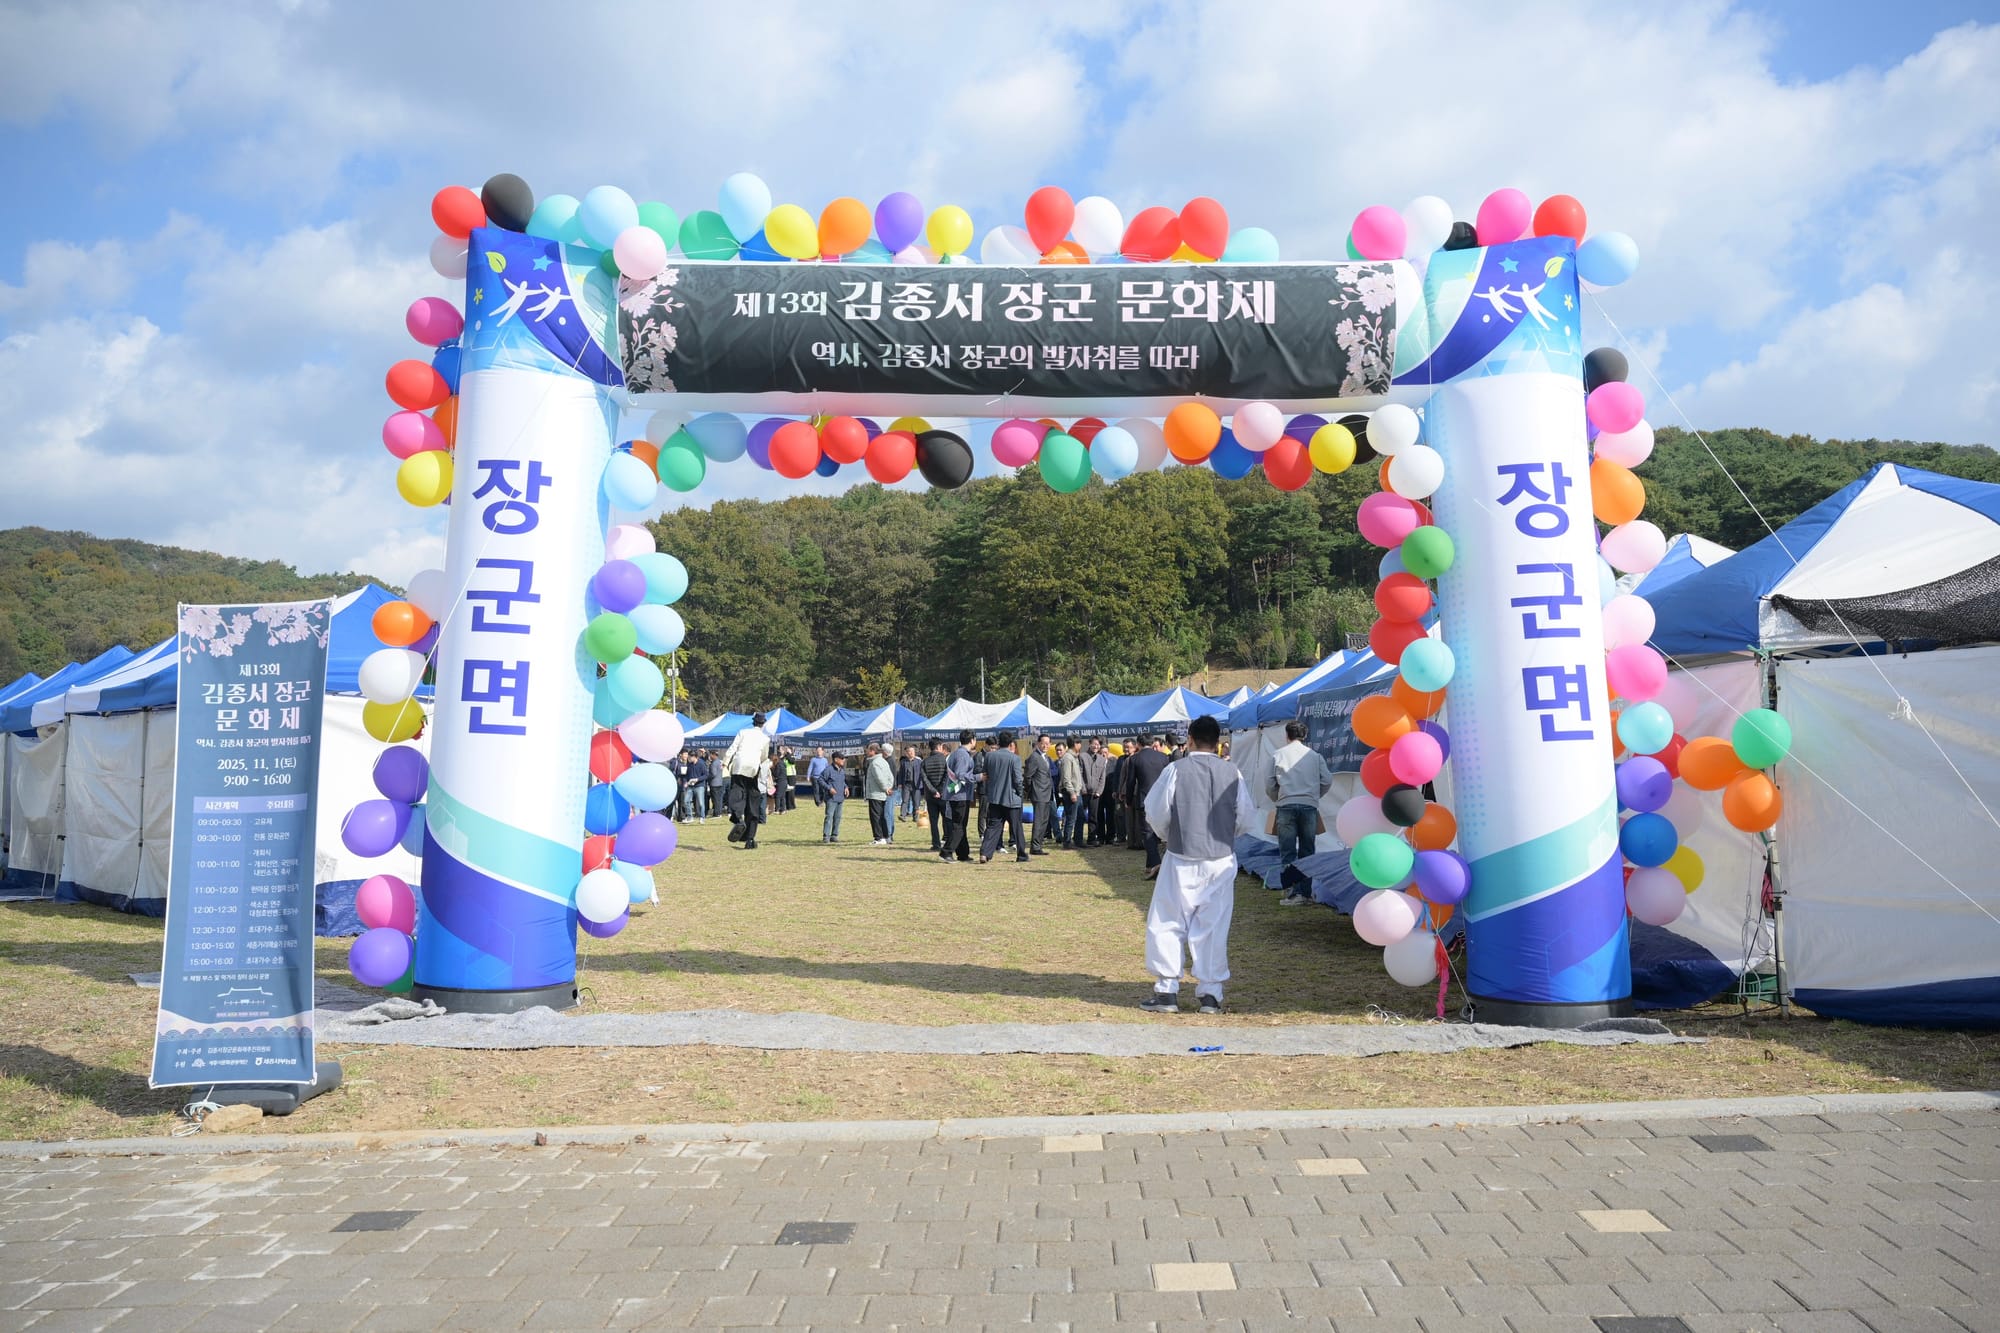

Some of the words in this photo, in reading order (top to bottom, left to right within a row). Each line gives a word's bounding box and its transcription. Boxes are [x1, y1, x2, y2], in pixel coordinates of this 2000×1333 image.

[732, 291, 828, 317] 제13회
[837, 281, 983, 321] 김종서
[999, 282, 1096, 322] 장군
[1117, 280, 1275, 324] 문화제
[811, 341, 868, 369] 역사,
[878, 343, 951, 369] 김종서
[959, 344, 1033, 369] 장군의
[1042, 345, 1141, 370] 발자취를
[1150, 345, 1199, 370] 따라
[461, 459, 552, 735] 장군면
[1497, 462, 1594, 741] 장군면
[239, 663, 280, 677] 제13회
[201, 682, 267, 704] 김종서
[274, 680, 311, 703] 장군
[220, 738, 243, 747] 김종서
[246, 738, 269, 747] 장군의
[217, 759, 248, 770] 2025.
[254, 759, 269, 770] 11.
[274, 757, 297, 769] 1(토)
[224, 775, 248, 787] 9:00
[264, 774, 291, 785] 16:00
